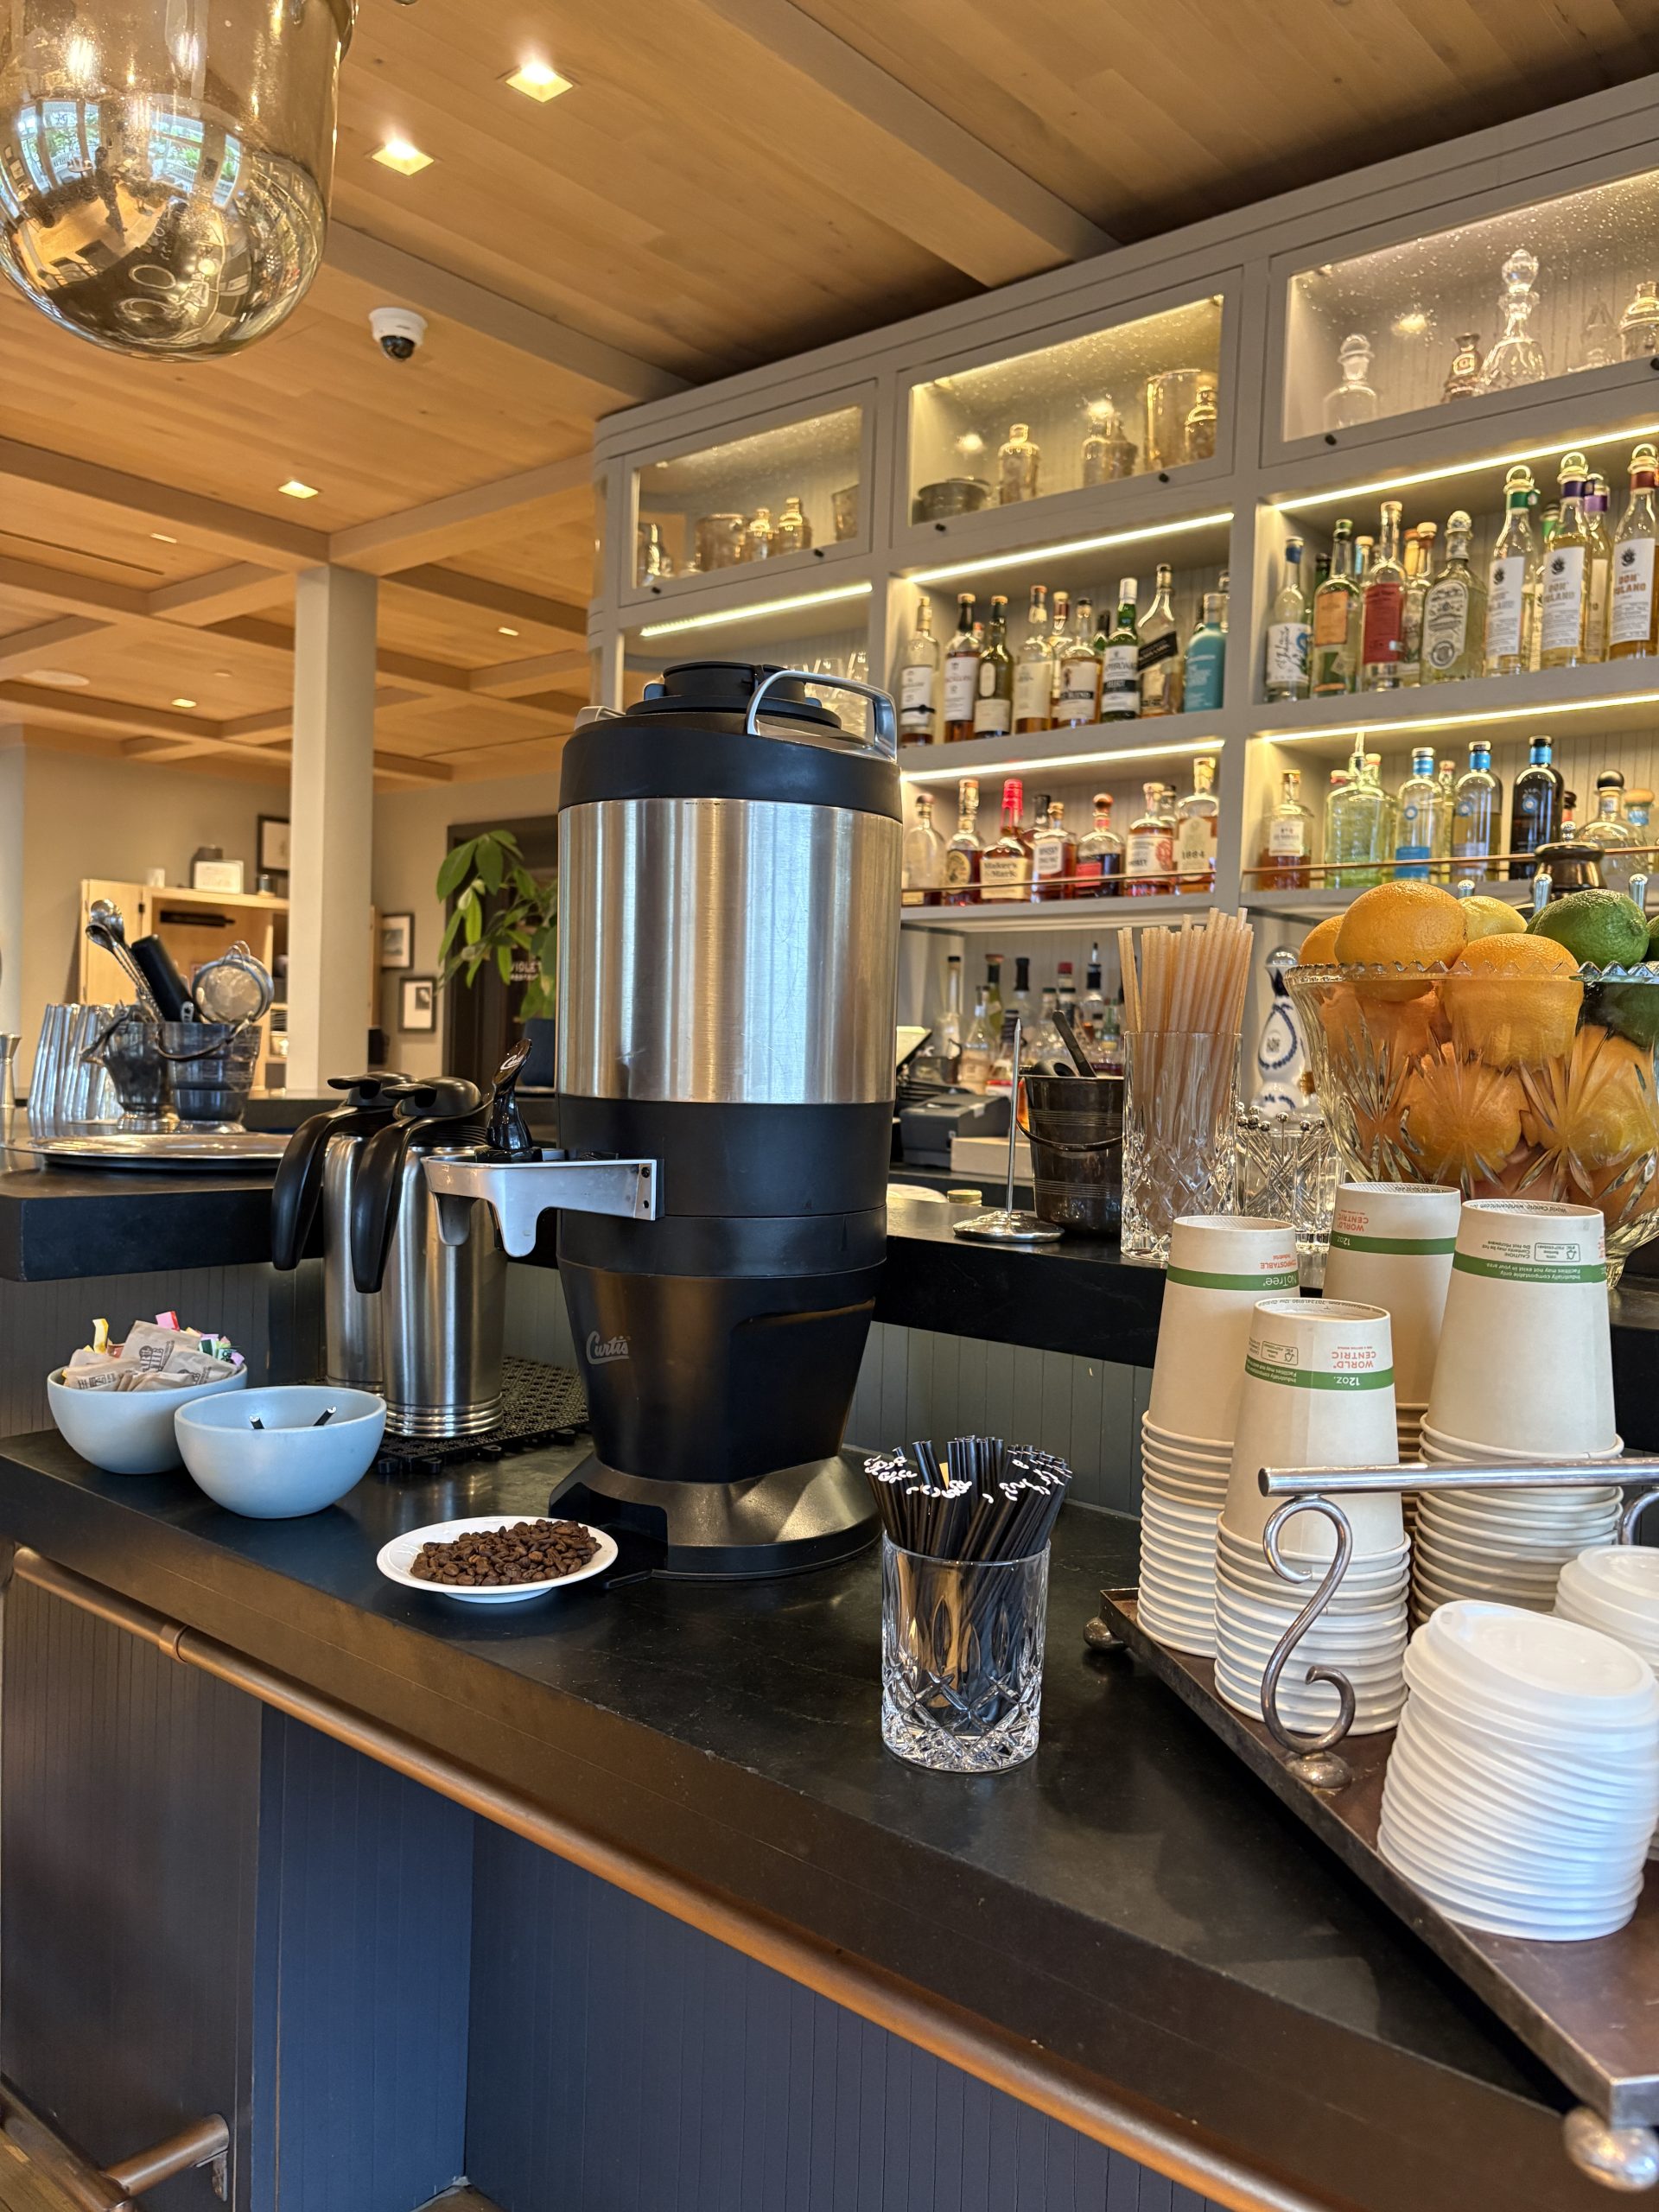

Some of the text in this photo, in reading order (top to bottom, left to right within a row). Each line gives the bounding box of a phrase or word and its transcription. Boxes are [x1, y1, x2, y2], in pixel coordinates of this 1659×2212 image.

[1182, 850, 1205, 860] 1884
[1338, 1213, 1369, 1224] CENTRIC
[1513, 1271, 1550, 1280] compostable
[586, 1331, 630, 1365] Curtis
[1332, 1351, 1376, 1361] CENTRIC
